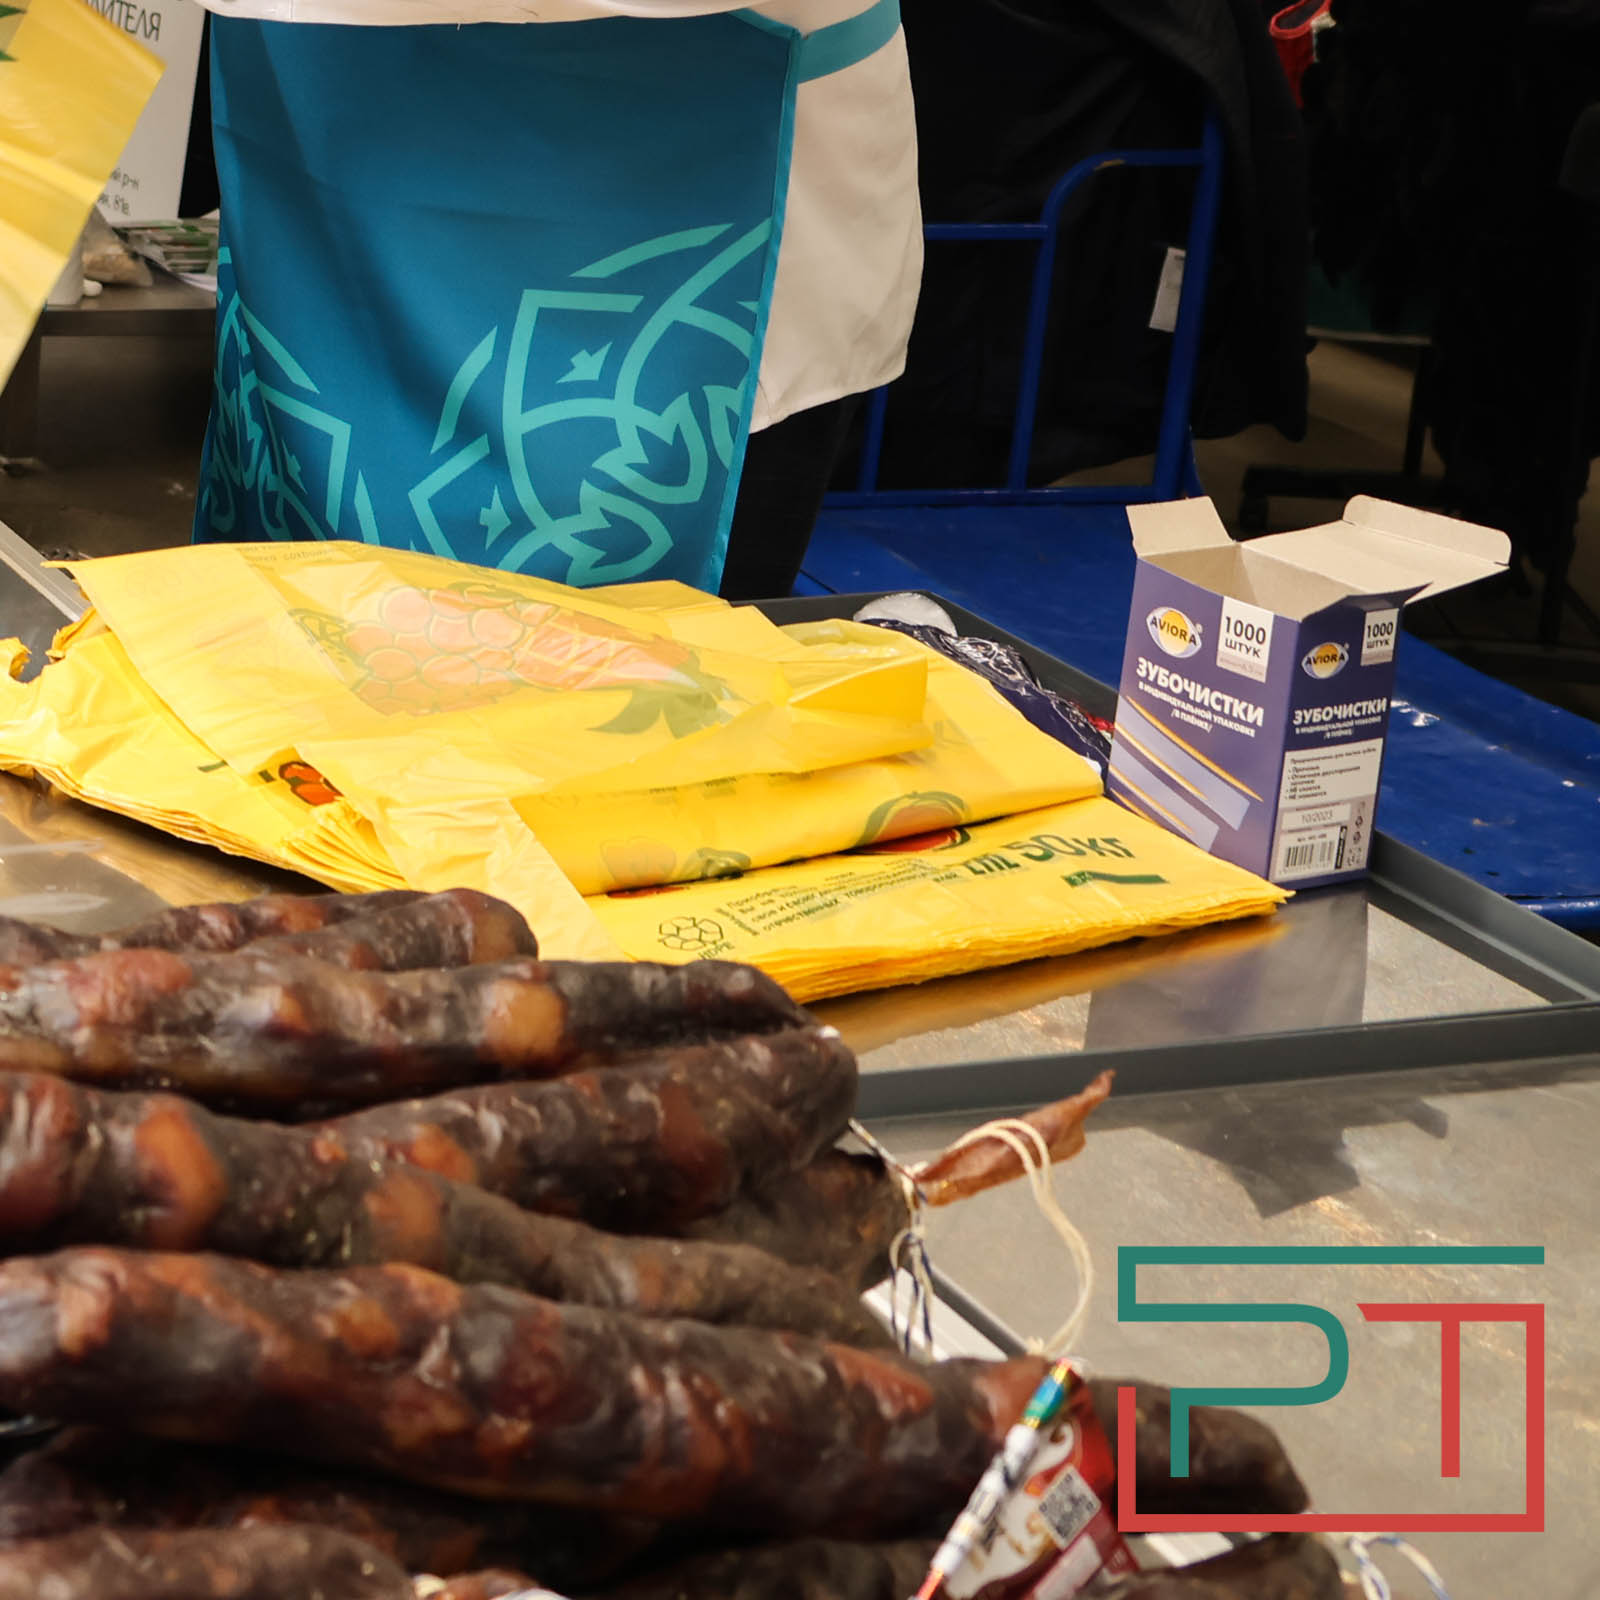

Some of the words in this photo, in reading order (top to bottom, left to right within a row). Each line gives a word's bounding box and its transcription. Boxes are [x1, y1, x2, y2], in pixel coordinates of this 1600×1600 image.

[1149, 616, 1198, 647] AVIORA
[1225, 615, 1267, 646] 1000
[1366, 621, 1394, 639] 1000
[1224, 637, 1262, 659] ШТУК
[1366, 638, 1390, 650] ШТУК
[1305, 652, 1346, 666] AVIORA
[1136, 655, 1265, 728] ЗУБОЧИСТКИ
[1293, 697, 1388, 726] ЗУБОЧИСТКИ
